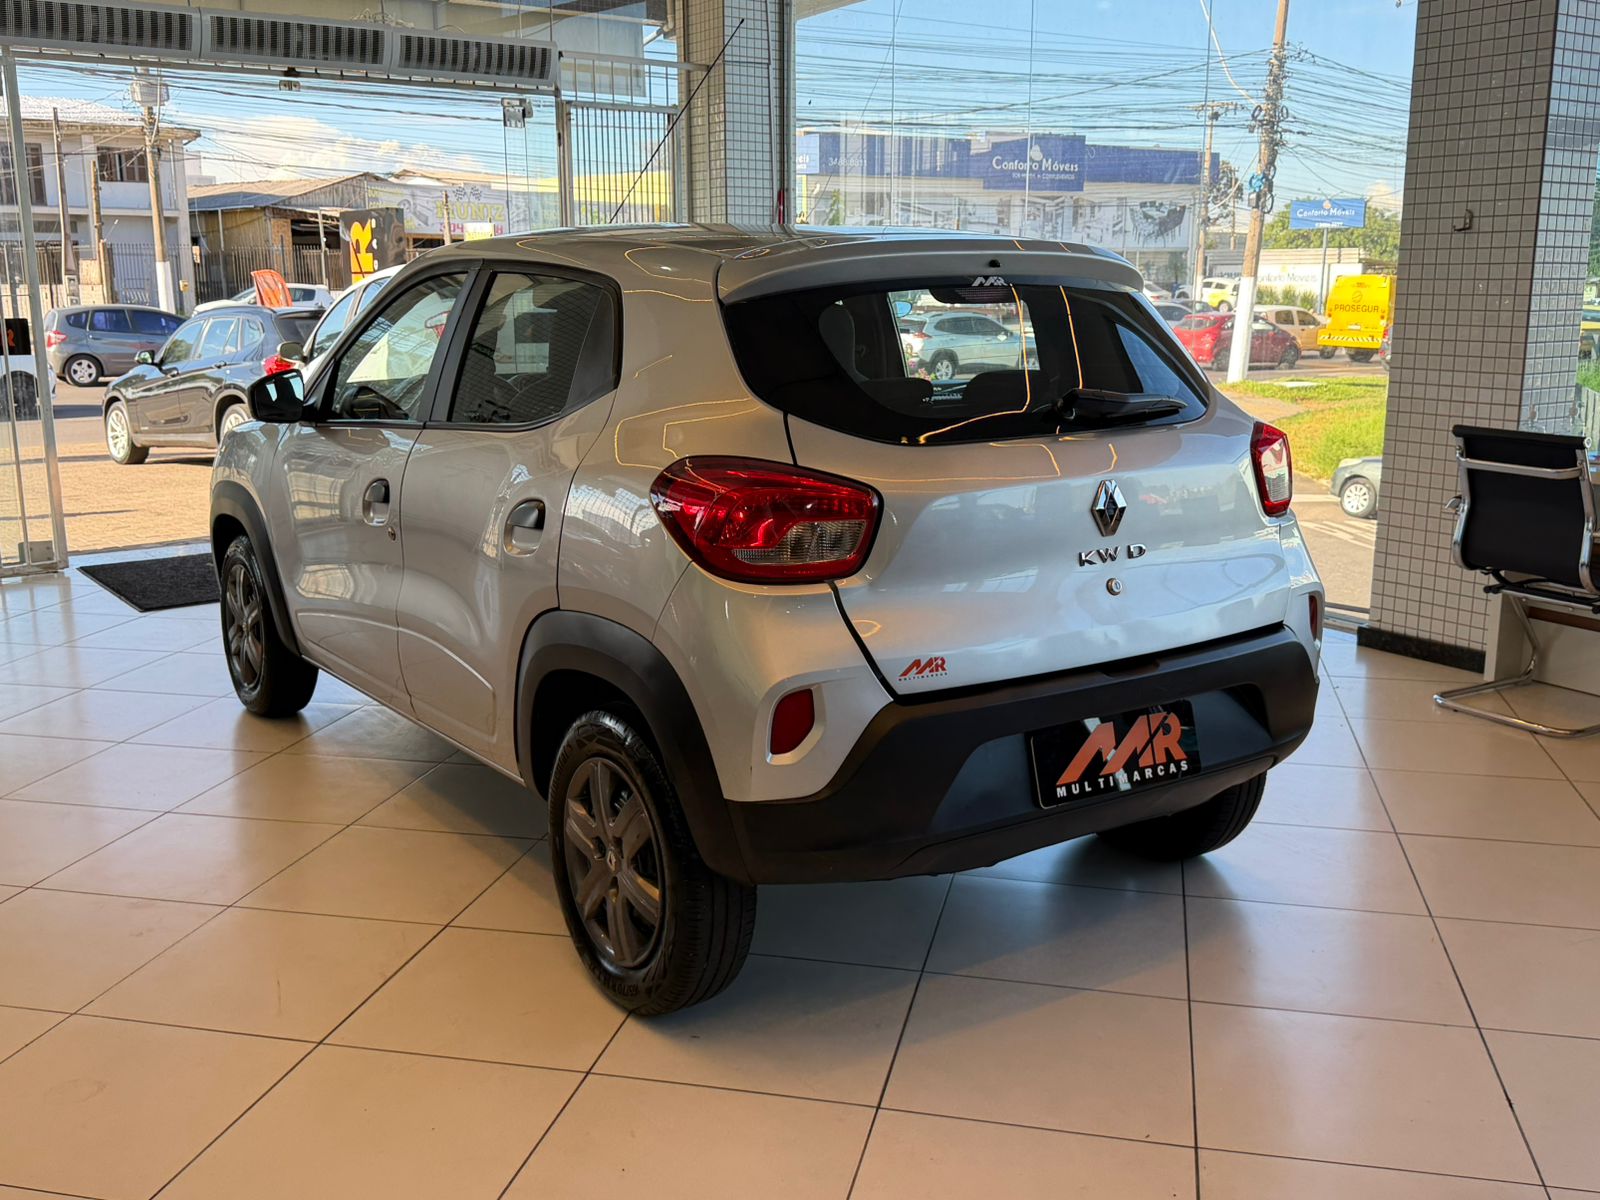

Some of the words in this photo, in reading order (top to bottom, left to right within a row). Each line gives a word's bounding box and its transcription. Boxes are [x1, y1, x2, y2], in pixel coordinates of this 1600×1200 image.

[1041, 157, 1078, 172] Móveis
[1334, 304, 1379, 313] PROSEGUR
[1078, 543, 1147, 567] KWD
[1055, 760, 1189, 799] MULTIMARCAS
